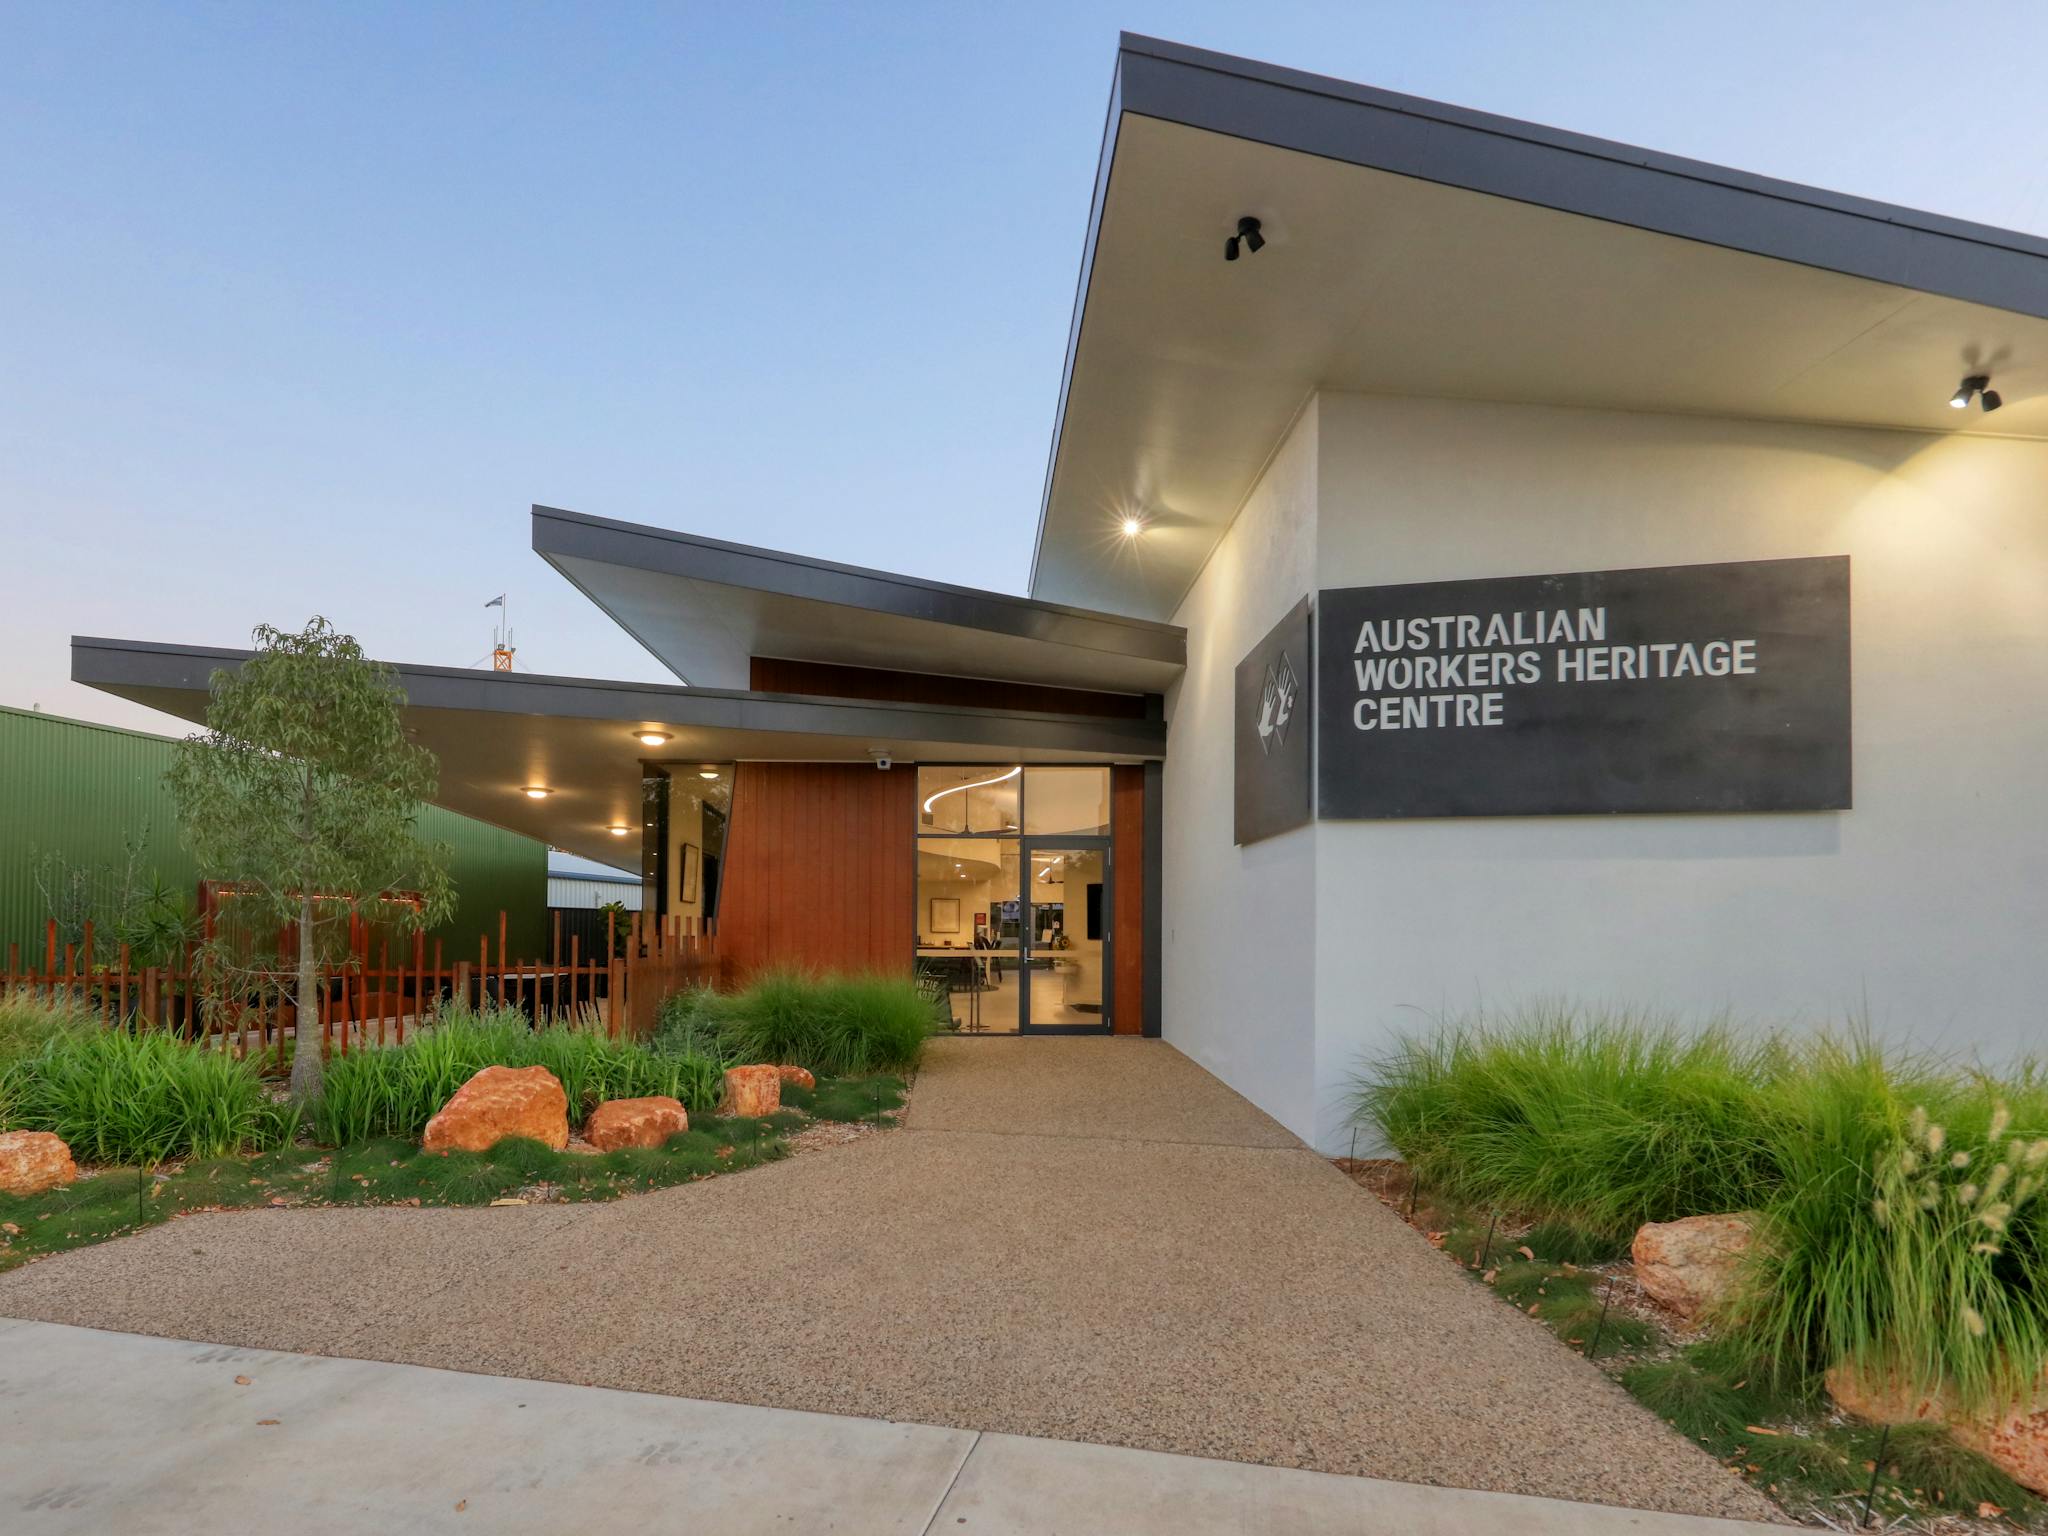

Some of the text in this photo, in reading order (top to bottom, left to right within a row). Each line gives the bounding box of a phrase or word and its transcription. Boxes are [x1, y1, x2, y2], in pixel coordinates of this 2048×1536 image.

[1355, 608, 1605, 654] AUSTRALIAN
[1355, 640, 1757, 692] WORKERS HERITAGE
[1353, 693, 1504, 731] CENTRE
